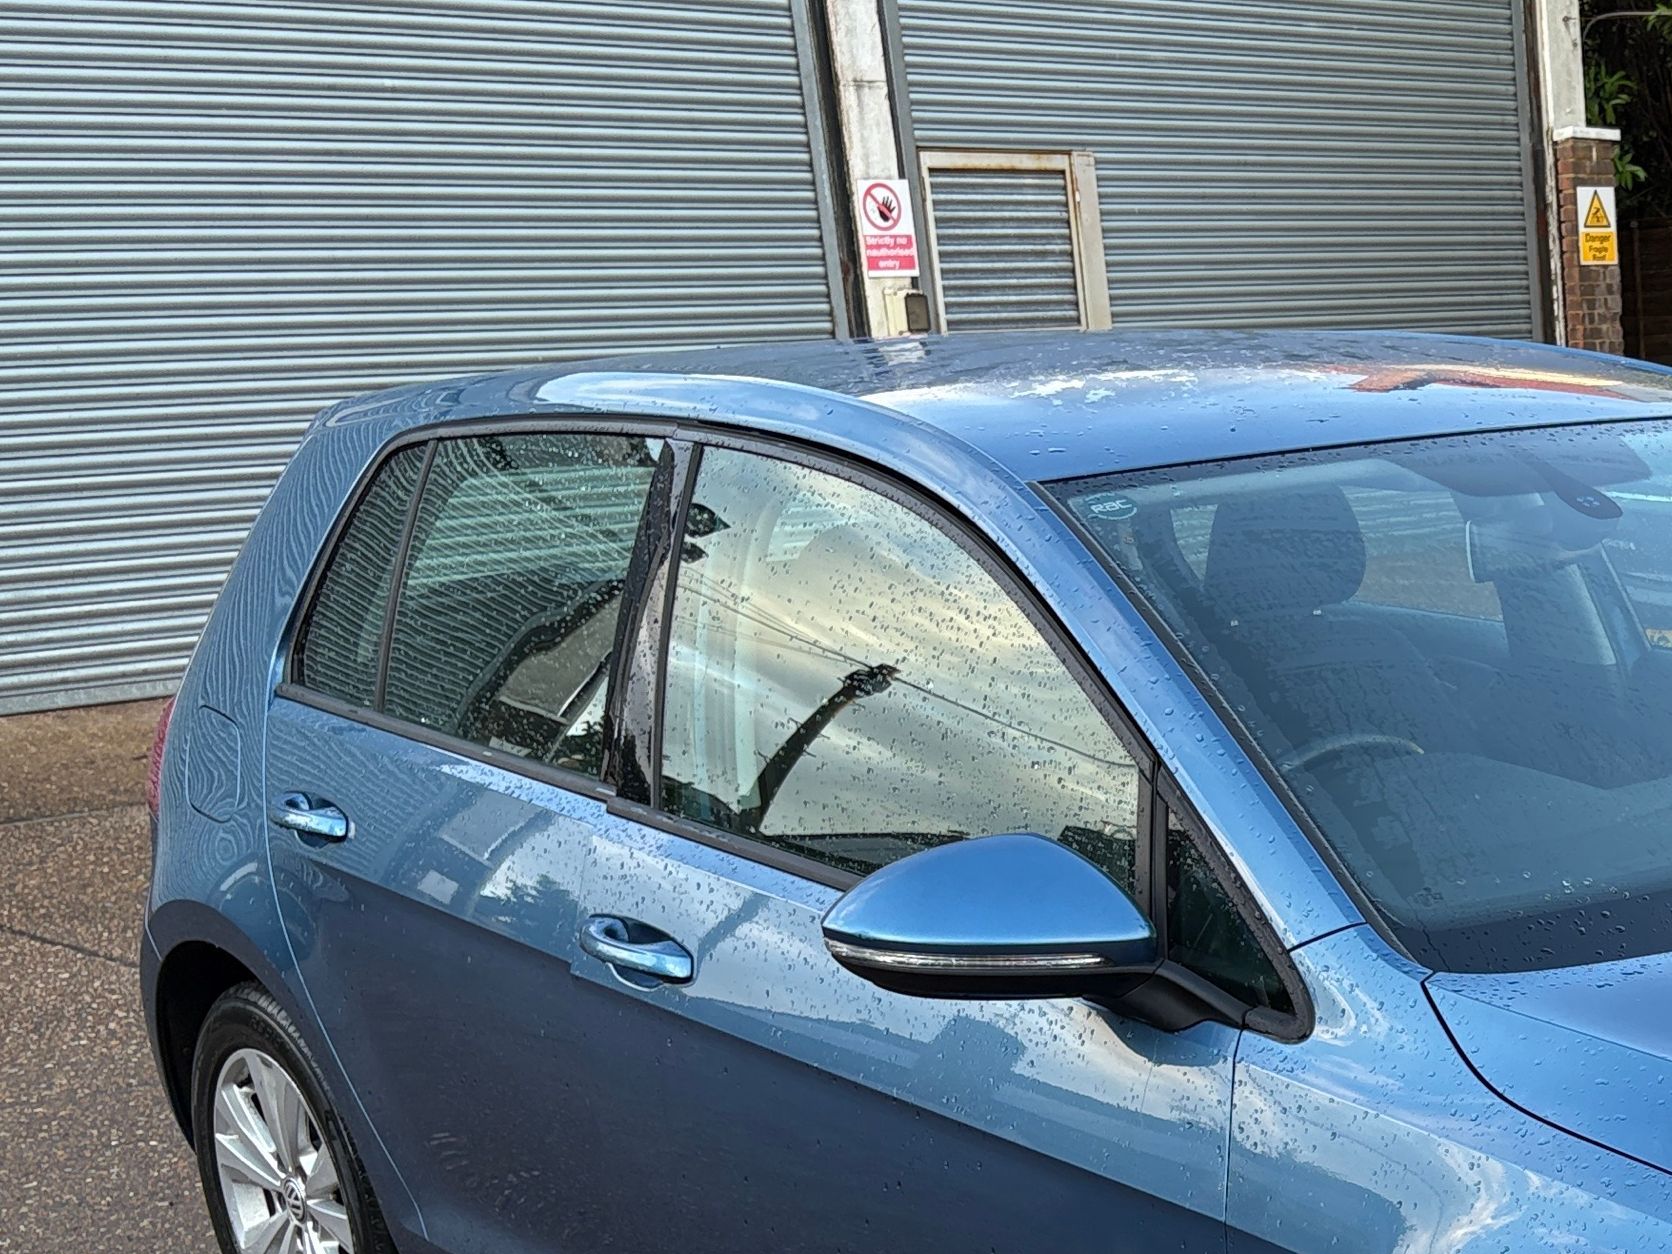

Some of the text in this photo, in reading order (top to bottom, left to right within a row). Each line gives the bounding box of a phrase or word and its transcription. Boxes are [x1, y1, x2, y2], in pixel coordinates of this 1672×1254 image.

[866, 236, 908, 248] Strictly no
[1585, 233, 1611, 244] Danger
[865, 247, 915, 257] nauthorised
[878, 259, 900, 270] entry
